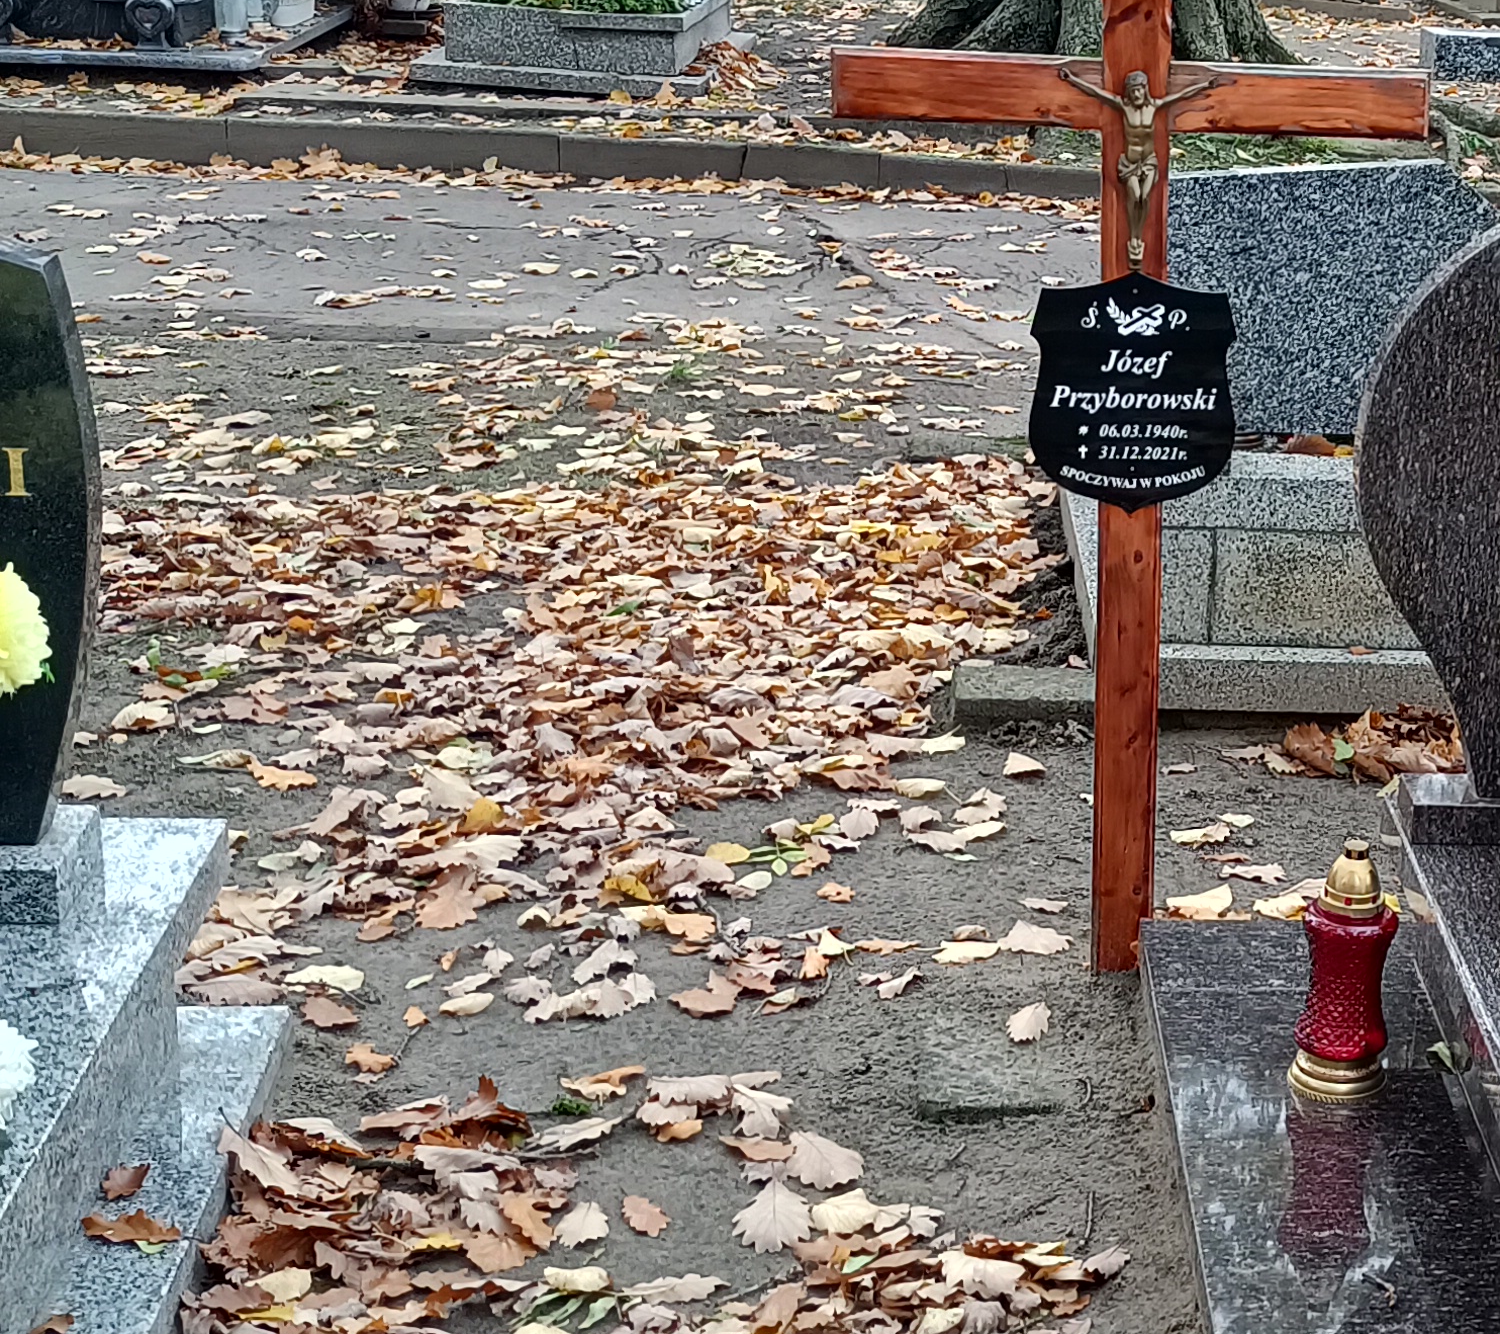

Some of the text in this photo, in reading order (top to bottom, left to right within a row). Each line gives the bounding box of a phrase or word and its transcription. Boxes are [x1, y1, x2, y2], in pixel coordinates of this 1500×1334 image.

[1167, 308, 1192, 332] P.
[1100, 349, 1173, 380] Józef
[1049, 384, 1218, 415] Przyborowski
[1098, 423, 1189, 440] 06.03.1940r.
[1098, 444, 1188, 461] 31.12.2021r.
[1059, 464, 1206, 490] SPOCZYWAJ W POKOJU
